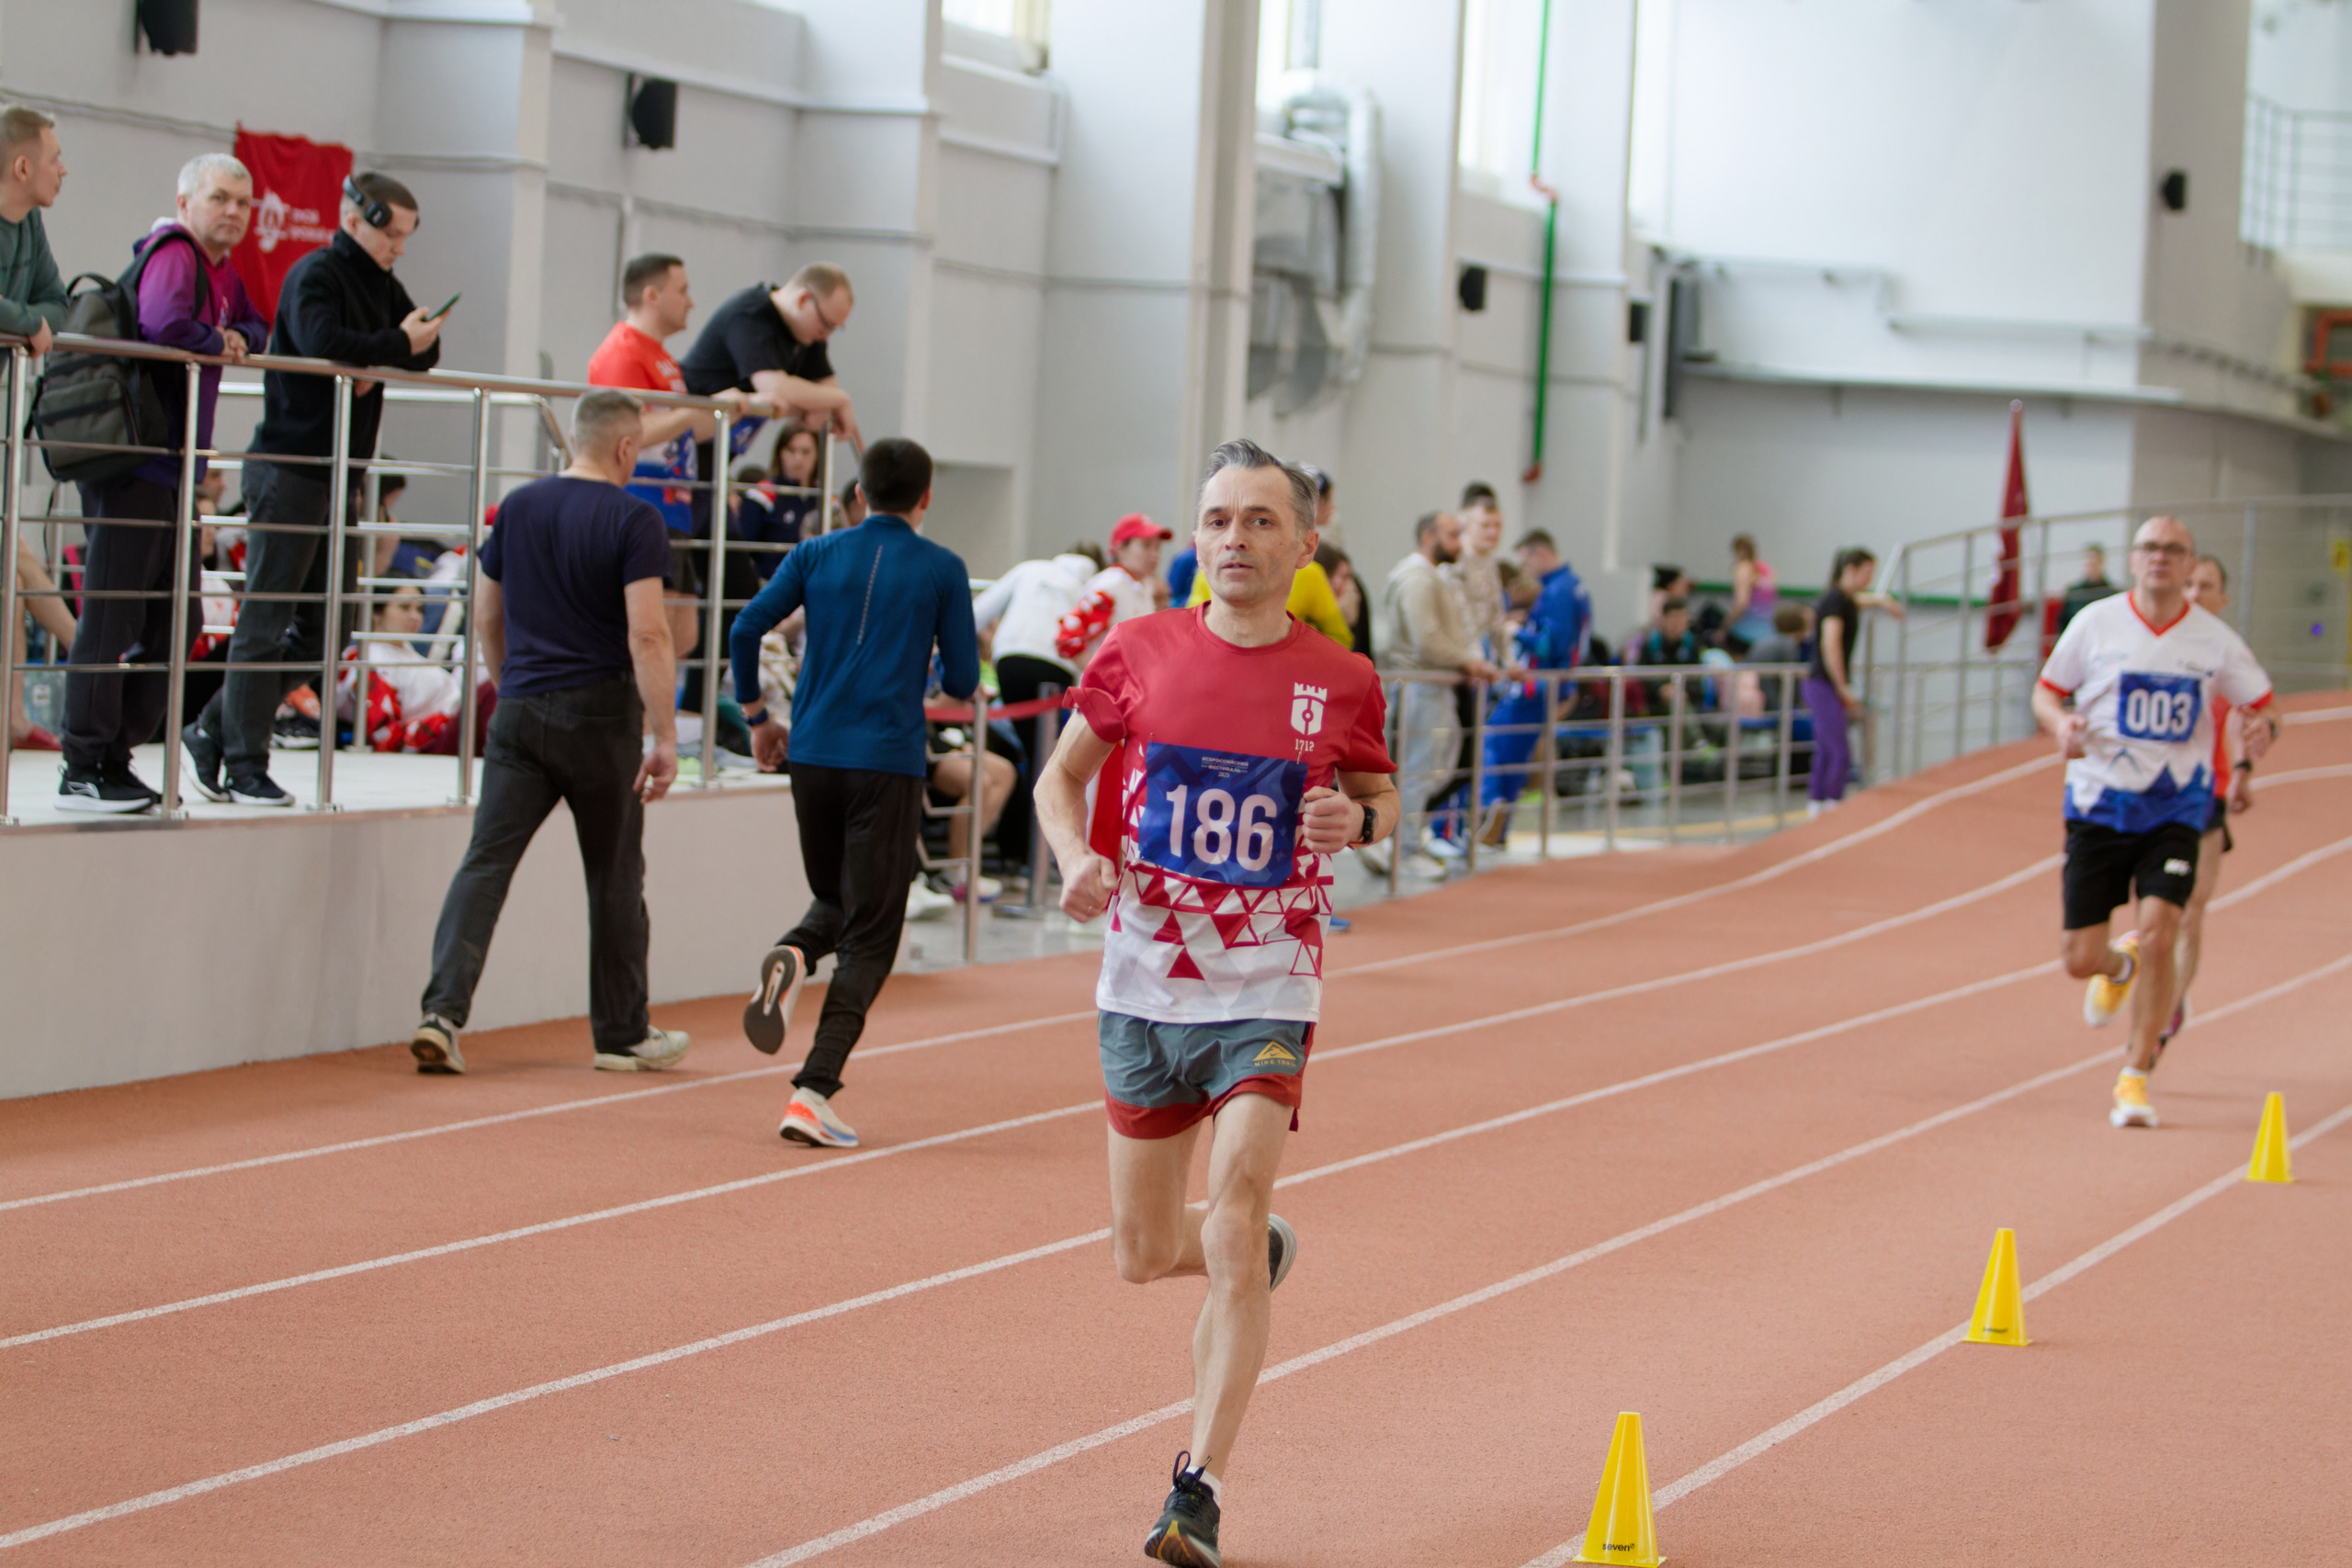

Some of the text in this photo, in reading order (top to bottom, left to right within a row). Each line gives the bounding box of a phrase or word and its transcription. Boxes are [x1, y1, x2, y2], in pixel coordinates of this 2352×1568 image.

[2126, 688, 2193, 736] 003
[1295, 739, 1315, 751] 1712
[1166, 784, 1277, 872] 186
